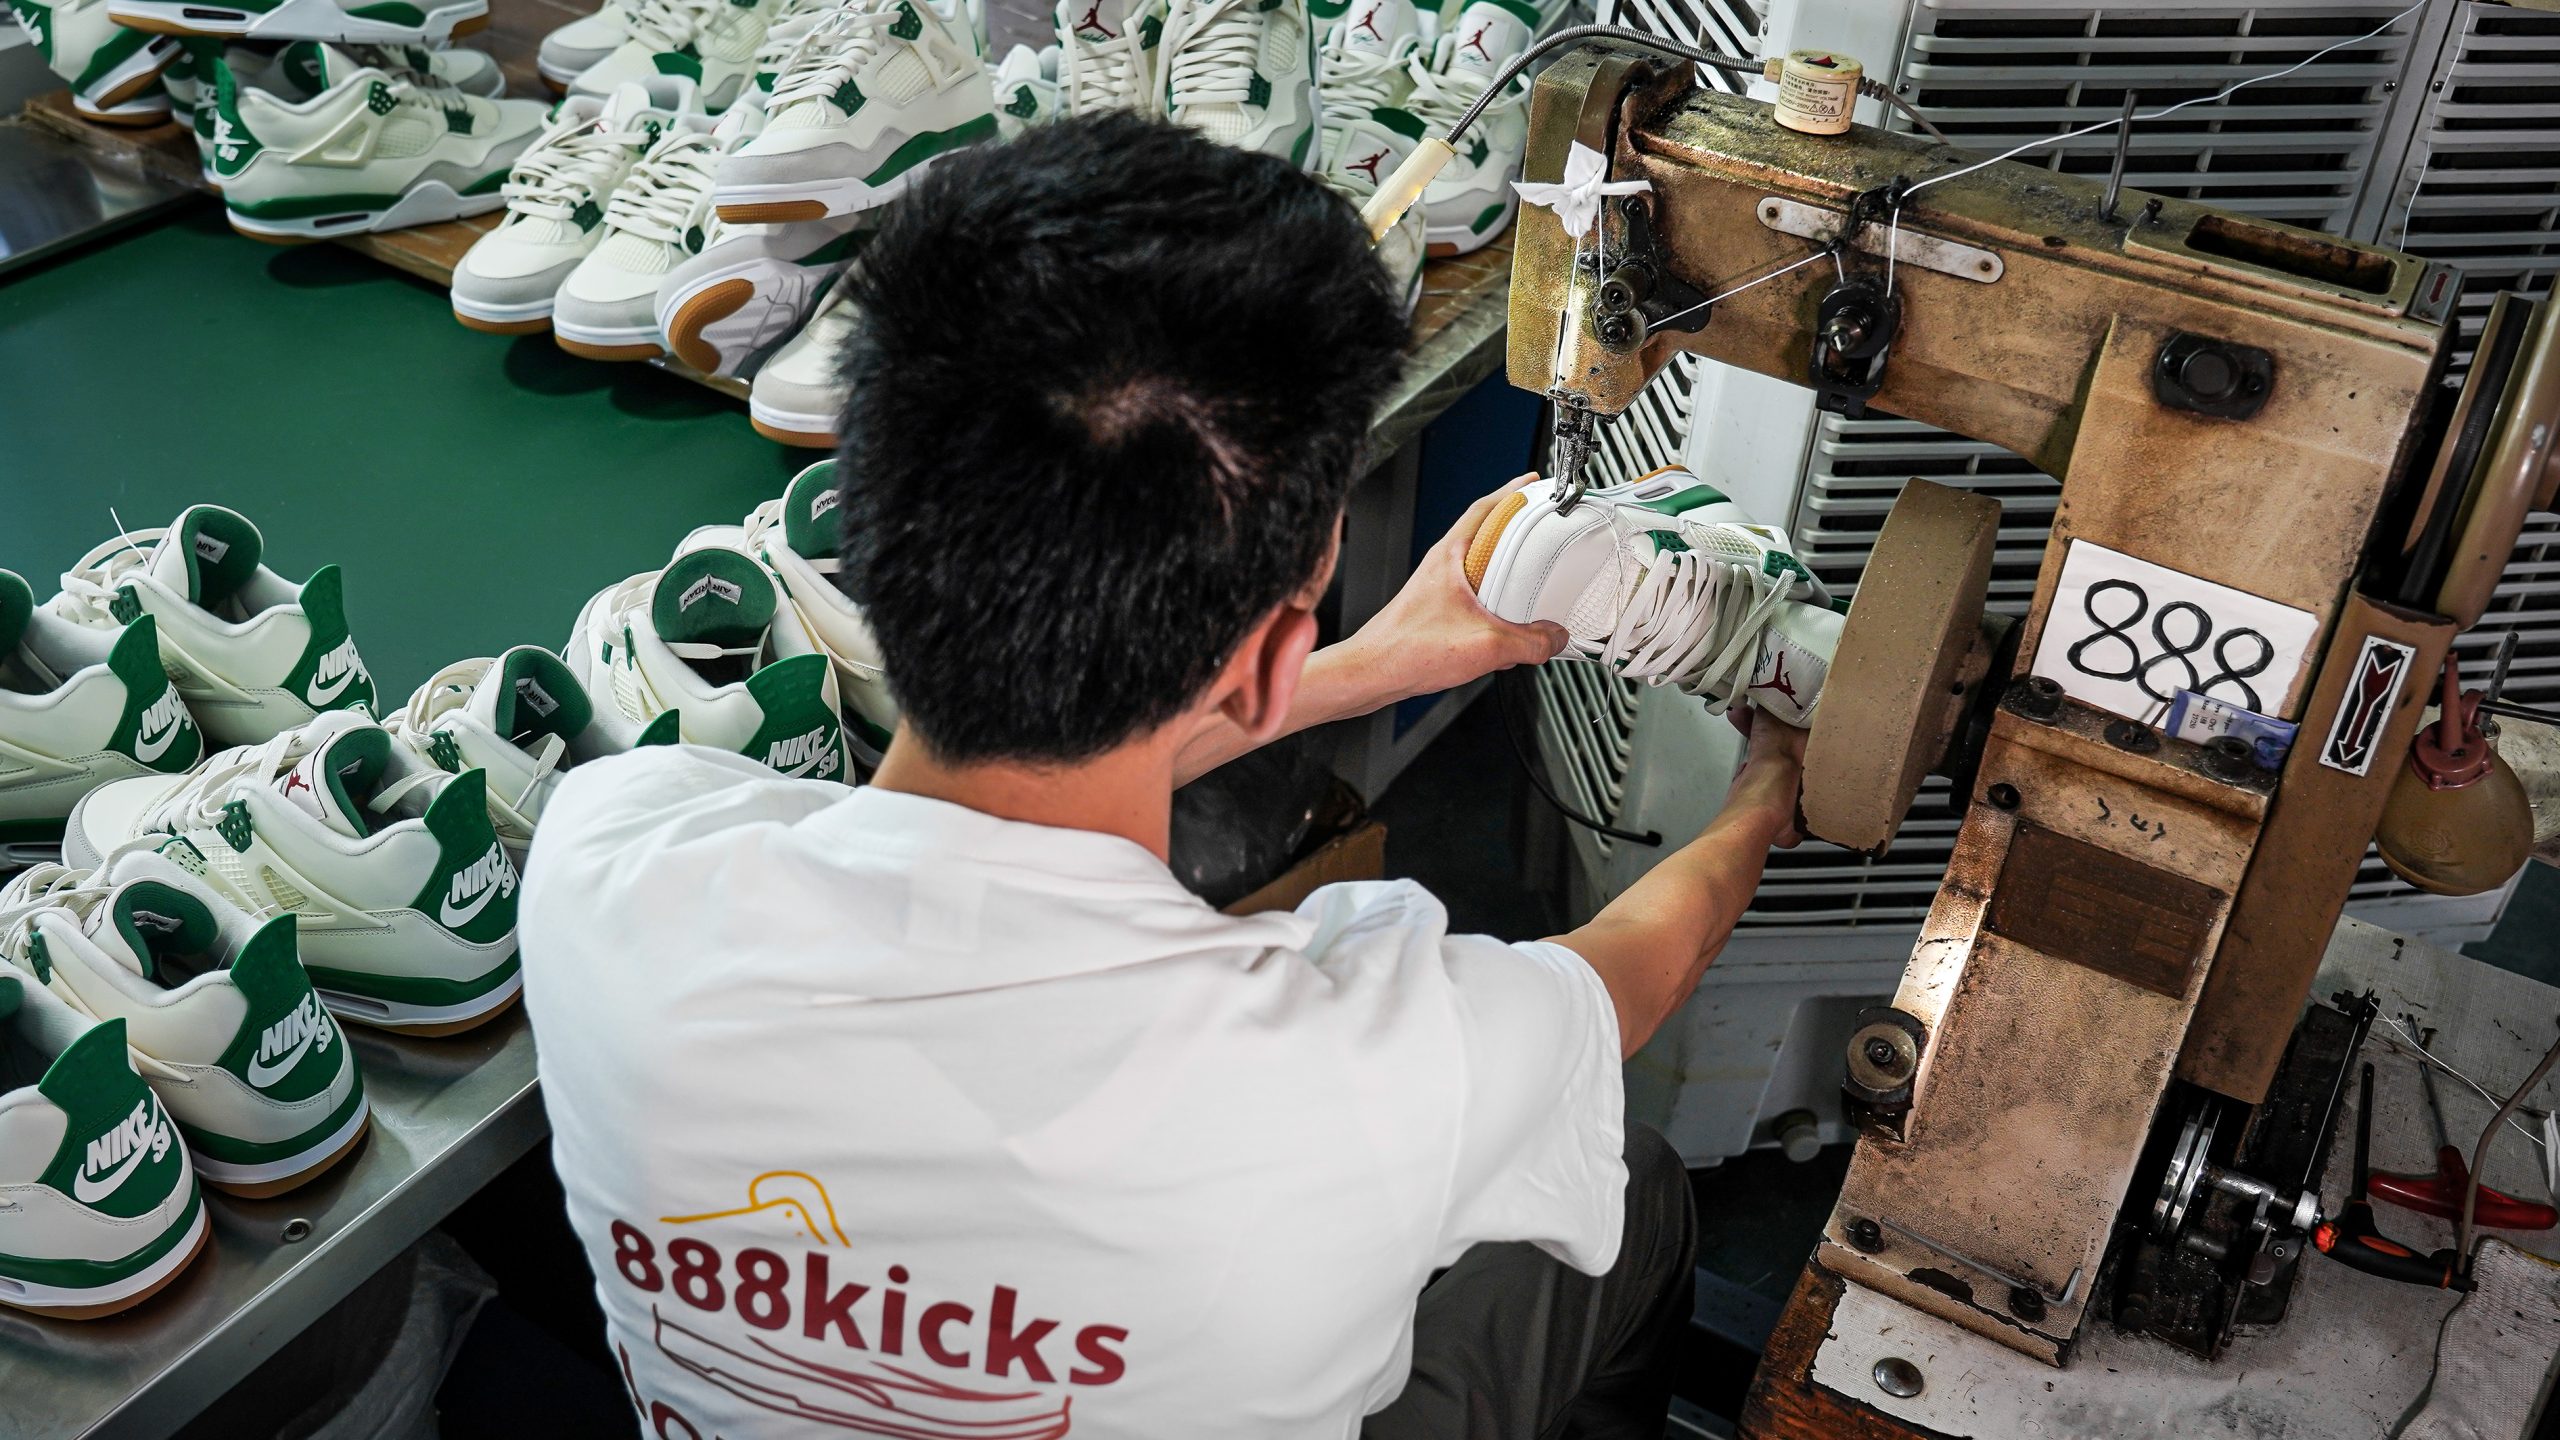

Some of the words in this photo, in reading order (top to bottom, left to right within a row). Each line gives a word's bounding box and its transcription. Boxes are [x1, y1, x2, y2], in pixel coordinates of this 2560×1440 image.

[196, 540, 217, 553] AIR
[712, 584, 732, 594] AIR
[2067, 578, 2275, 713] 888
[528, 690, 548, 706] AIR
[767, 725, 825, 768] NIKE
[817, 749, 839, 778] SB
[451, 841, 502, 904] NIKE
[261, 992, 316, 1063] NIKE
[87, 1099, 152, 1177] NIKE
[611, 1218, 1130, 1387] 888kicks
